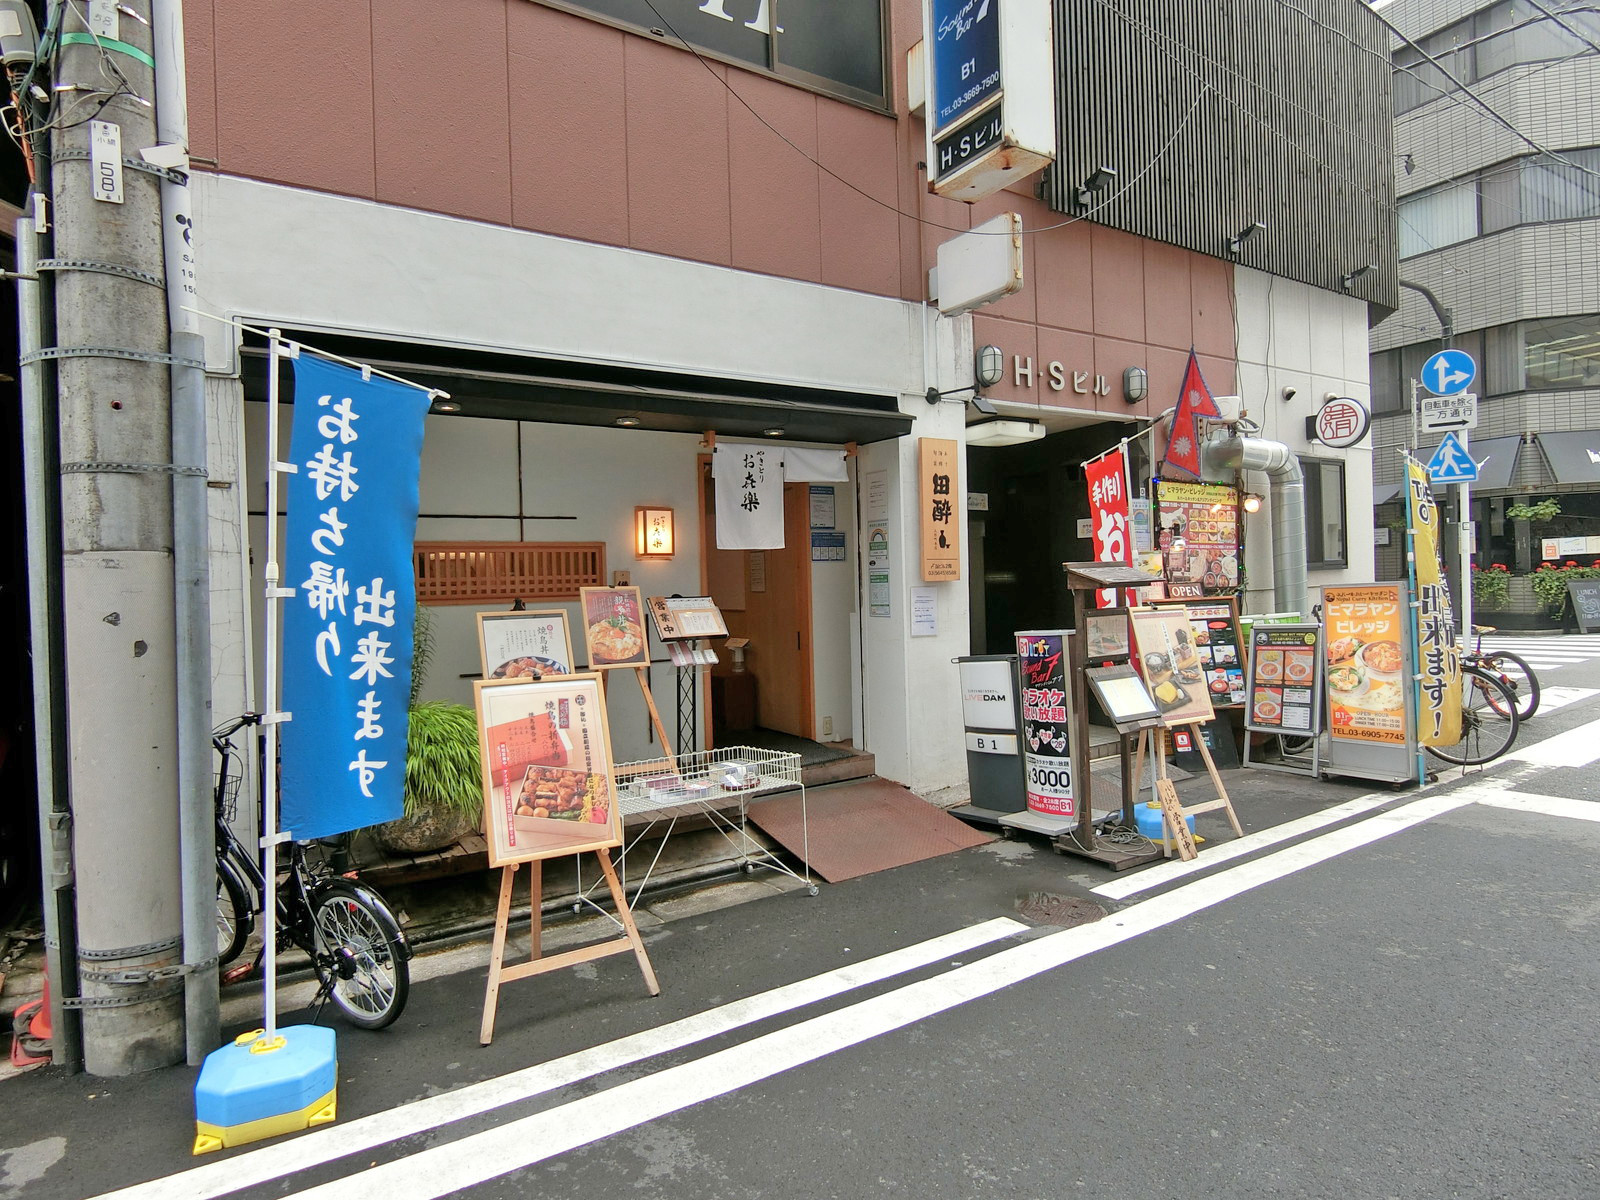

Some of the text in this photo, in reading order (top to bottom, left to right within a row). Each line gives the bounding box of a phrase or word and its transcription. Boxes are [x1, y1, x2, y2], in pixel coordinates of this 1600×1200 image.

[956, 16, 974, 41] Bar
[961, 58, 976, 80] B1
[100, 162, 115, 192] 58
[1424, 398, 1473, 410] 自転車を除く
[1425, 409, 1473, 419] 一方通行
[756, 451, 766, 483] やきとり
[1092, 472, 1121, 508] 手作り
[1172, 586, 1201, 597] OPEN
[1327, 602, 1397, 616] ヒマラヤン
[655, 600, 675, 635] 営業中
[1336, 620, 1390, 634] ビレッジ
[1020, 642, 1028, 654] B1
[1022, 651, 1062, 682] Sound 7
[1031, 671, 1047, 684] Bar
[1023, 687, 1064, 706] カラオケ
[1024, 706, 1066, 722] 歌い放題
[1335, 711, 1345, 719] B1
[1060, 800, 1072, 811] B1
